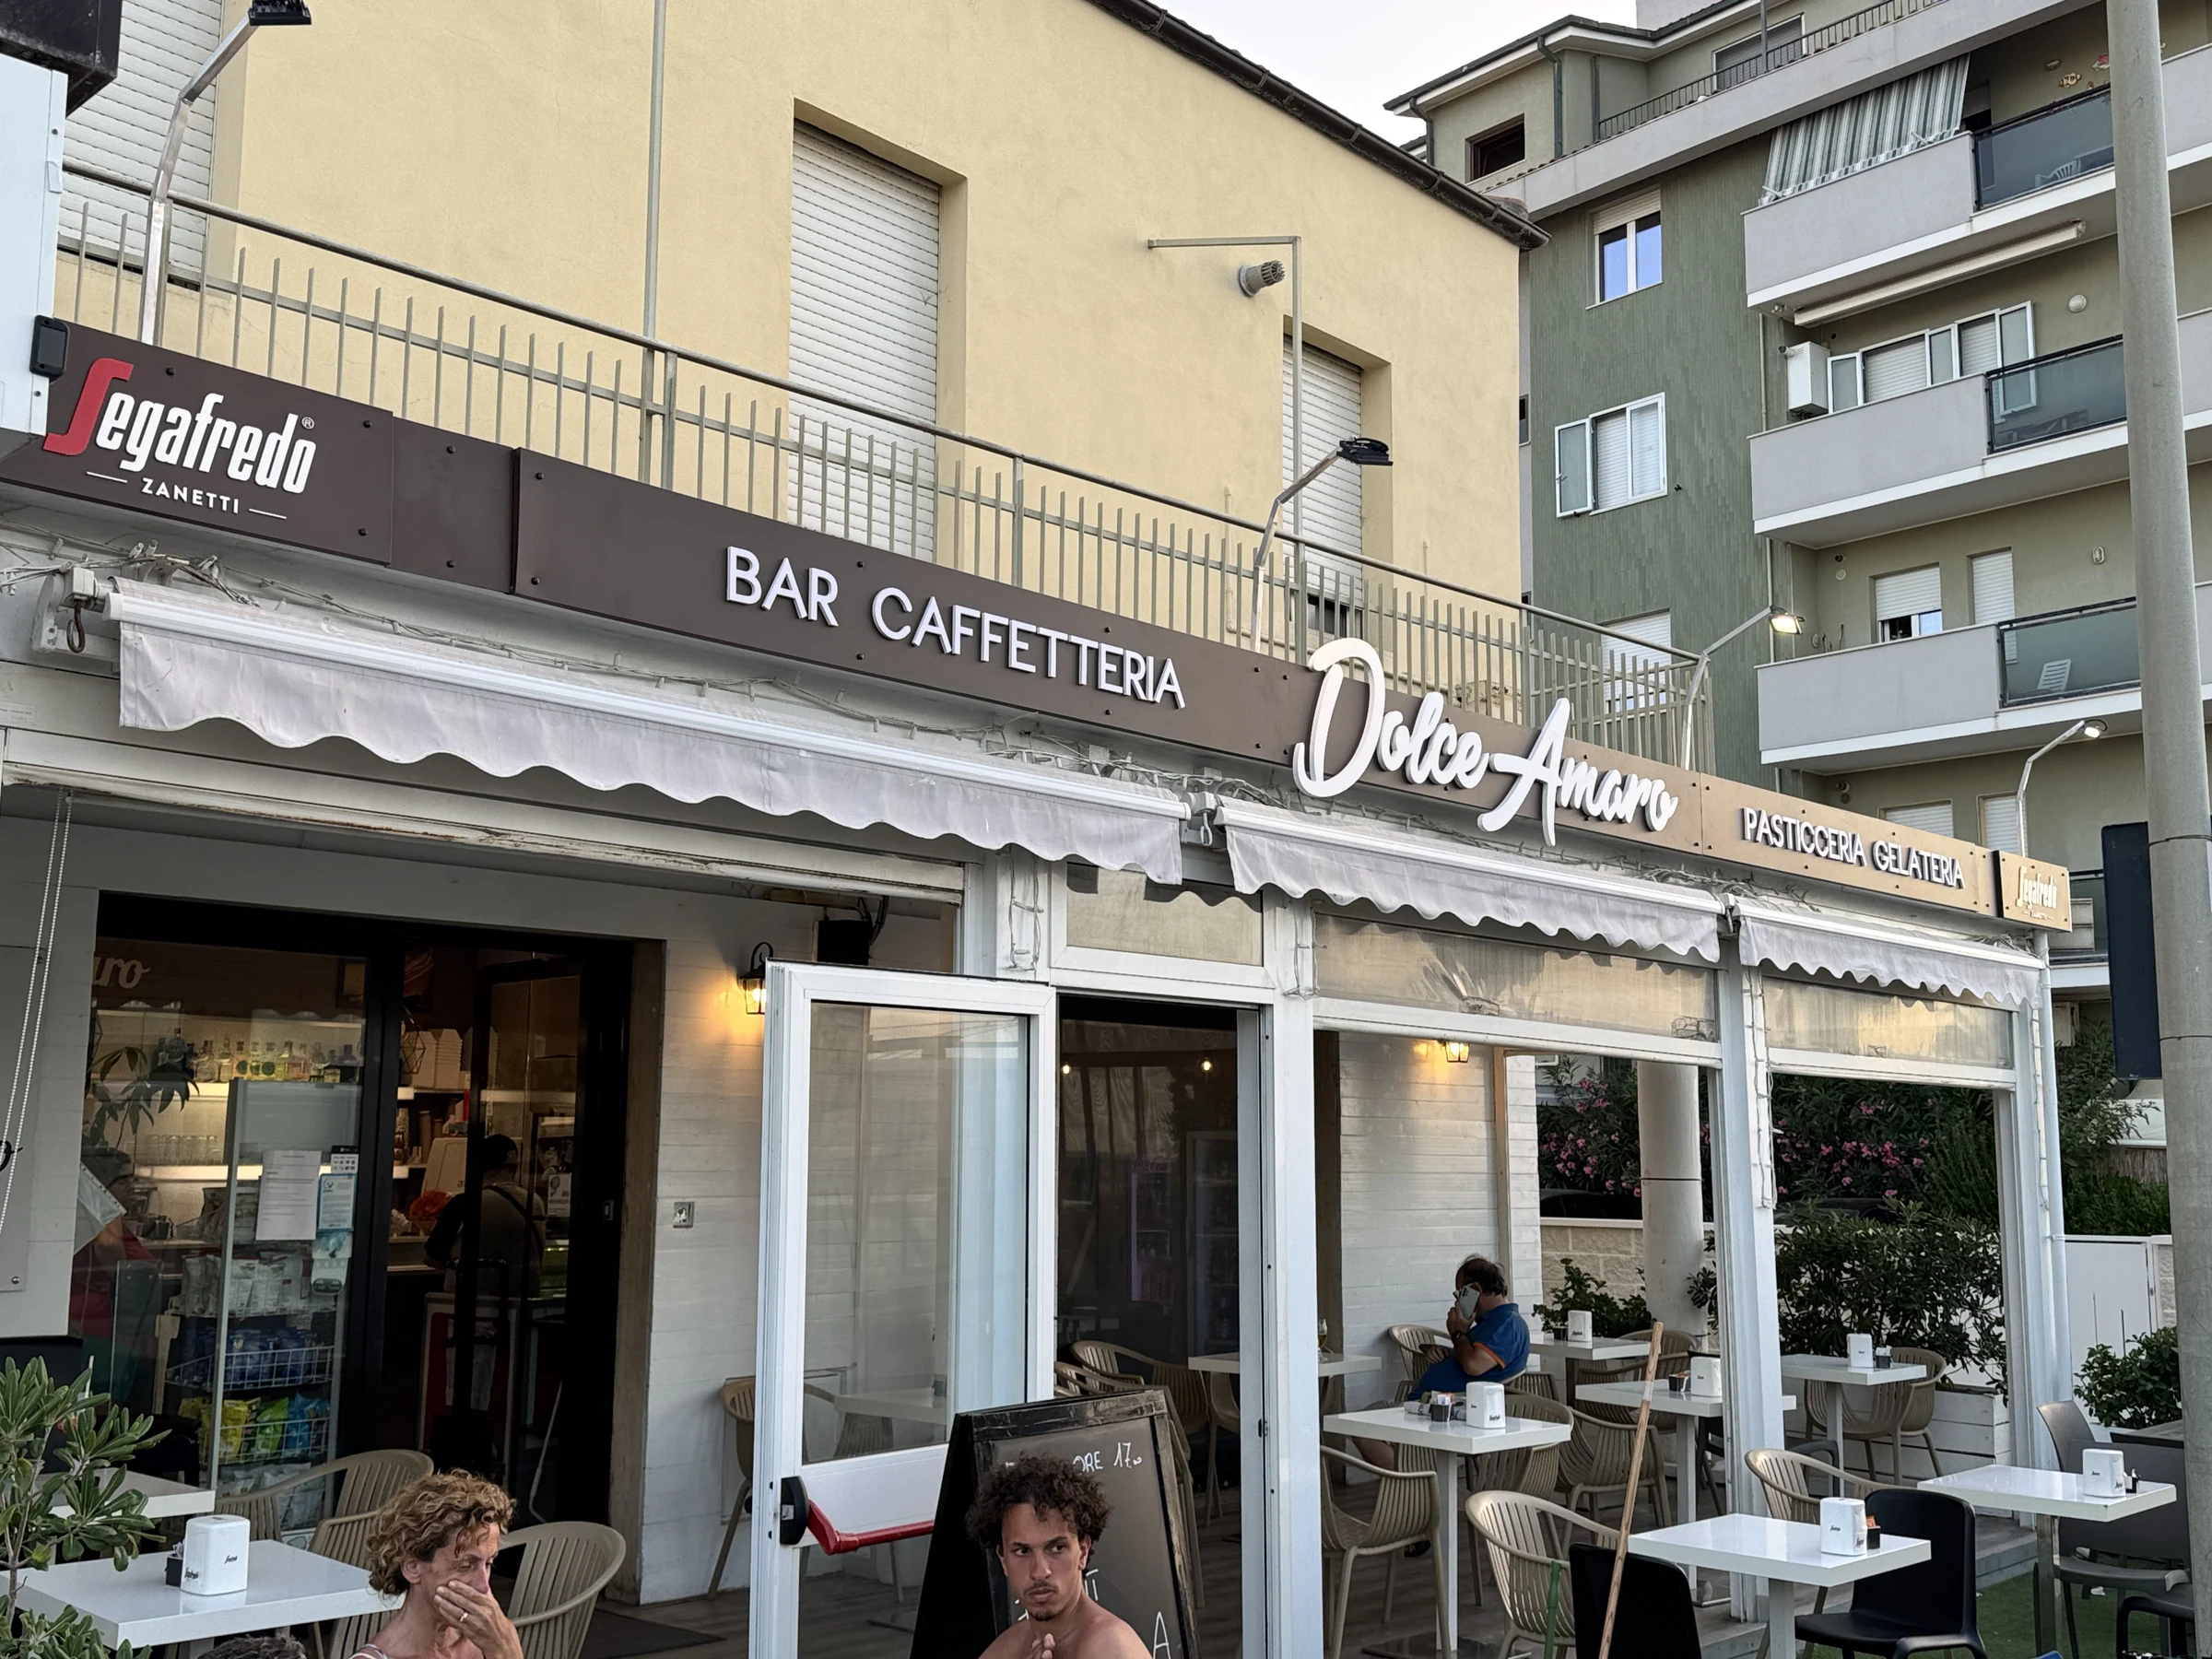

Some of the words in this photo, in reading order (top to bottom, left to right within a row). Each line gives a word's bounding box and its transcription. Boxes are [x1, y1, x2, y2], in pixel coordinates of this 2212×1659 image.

[42, 358, 317, 494] Segafredo
[142, 477, 240, 514] ZANETTI
[725, 546, 840, 628] BAR
[871, 586, 1186, 710] CAFFETTERIA
[1292, 637, 1490, 798] Dolce
[1477, 697, 1679, 847] Amaro
[1742, 806, 1867, 866] PASTICCERIA
[1872, 840, 1966, 889] GELATERIA
